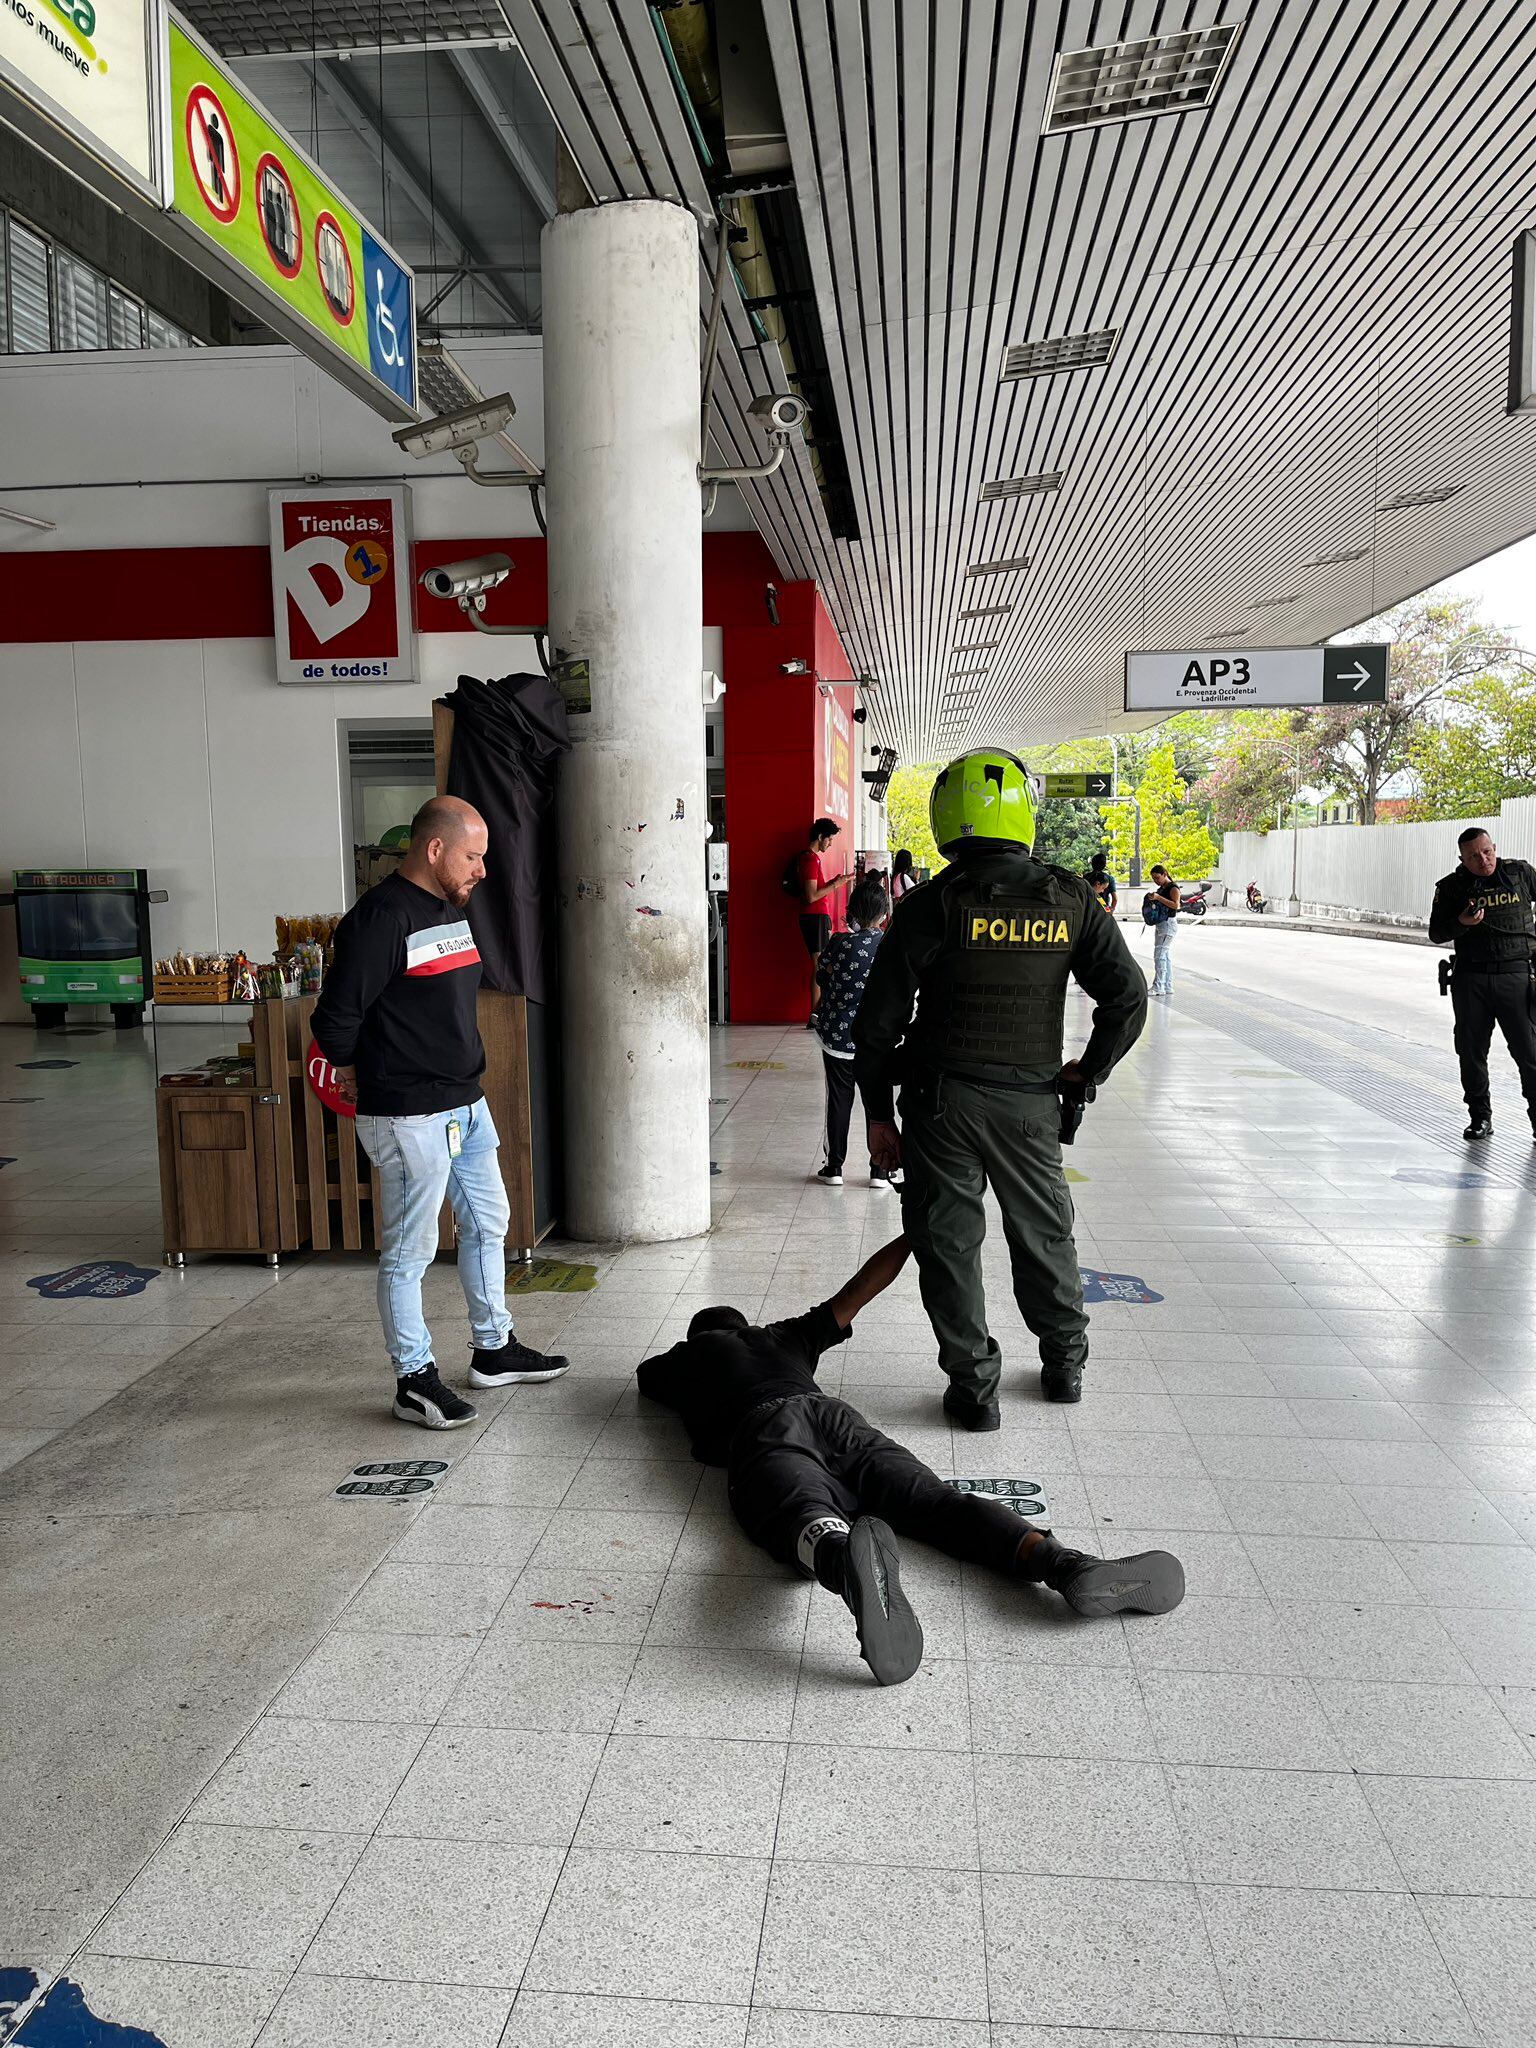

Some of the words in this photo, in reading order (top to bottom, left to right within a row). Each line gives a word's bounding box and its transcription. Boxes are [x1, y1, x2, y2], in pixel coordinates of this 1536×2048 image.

[38, 20, 90, 77] mueve
[298, 515, 380, 533] Tiendas
[302, 664, 325, 678] de
[331, 662, 388, 678] todos!
[1181, 658, 1251, 687] AP3
[1184, 688, 1217, 697] Provenza
[1218, 686, 1257, 696] Occidental
[1201, 694, 1236, 702] Ladrillera
[971, 917, 1069, 943] POLICIA
